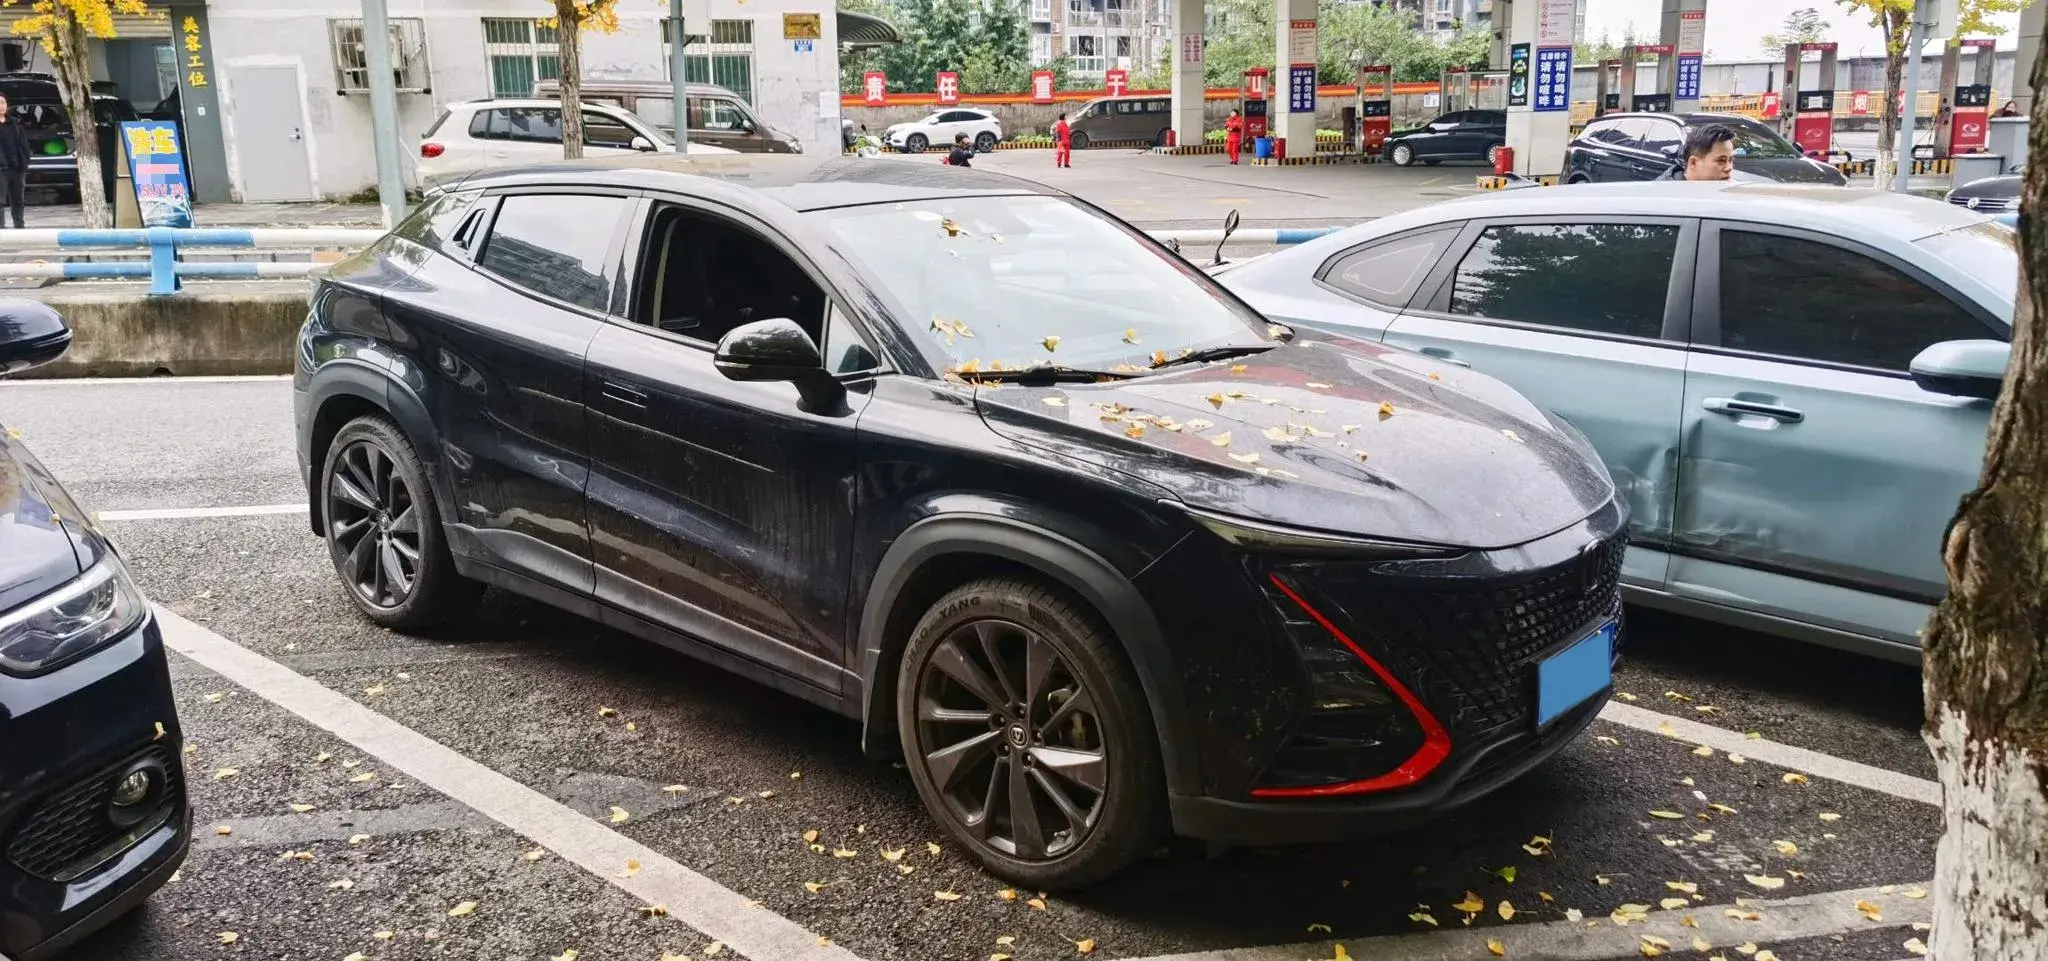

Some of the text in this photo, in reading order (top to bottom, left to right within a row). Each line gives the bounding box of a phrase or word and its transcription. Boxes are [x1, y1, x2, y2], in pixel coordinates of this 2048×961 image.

[183, 16, 208, 86] 美容工位
[1538, 61, 1552, 107] 请勿喧哗
[1553, 61, 1567, 106] 请勿鸣笛
[938, 596, 982, 619] YANG
